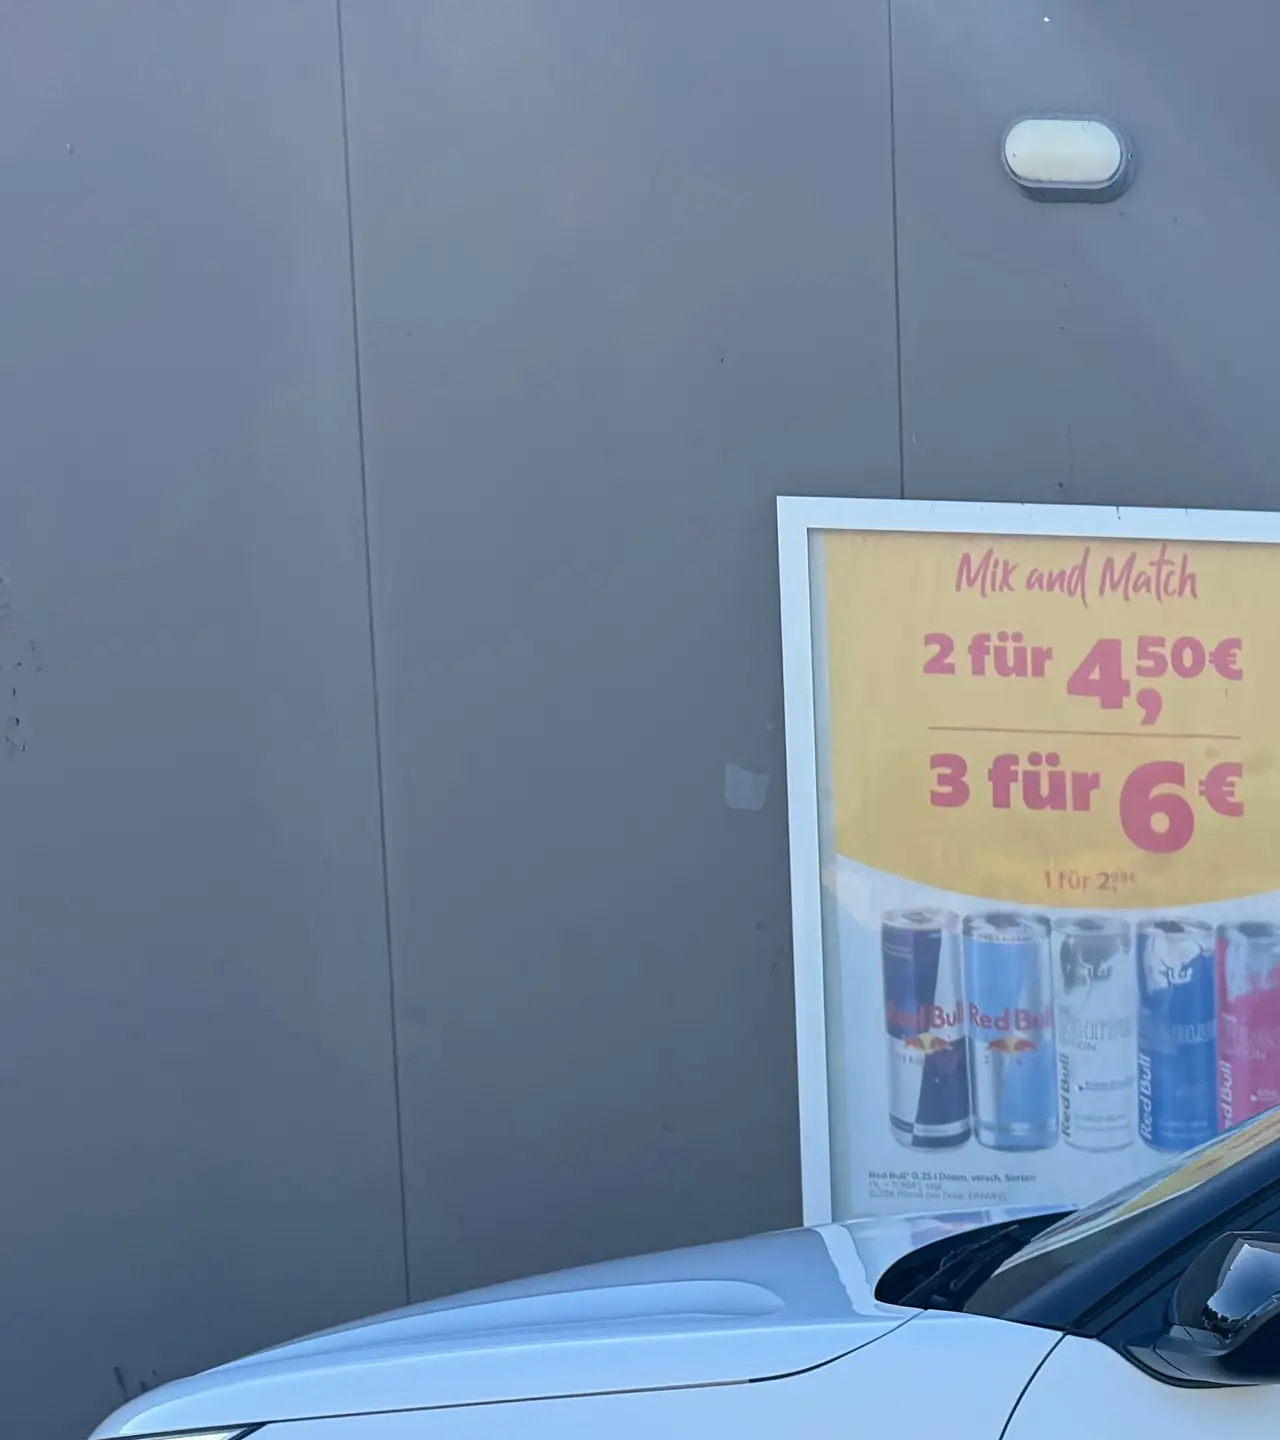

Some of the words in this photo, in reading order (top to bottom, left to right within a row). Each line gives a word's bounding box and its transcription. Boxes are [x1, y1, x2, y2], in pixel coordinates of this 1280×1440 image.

[955, 548, 1019, 598] Mix
[1026, 547, 1090, 609] and
[1099, 543, 1198, 602] Match
[922, 632, 956, 676] 2
[968, 630, 1053, 678] für
[928, 753, 970, 808] 3
[988, 751, 1100, 812] für
[1119, 760, 1244, 854] 6€
[1044, 869, 1052, 889] 1
[1058, 869, 1090, 890] für
[968, 1002, 1010, 1031] Red
[1058, 1052, 1071, 1093] Bull
[1138, 1052, 1152, 1095] Bull
[1219, 1060, 1232, 1103] Bull
[1060, 1094, 1071, 1138] Red
[1139, 1095, 1152, 1140] Red
